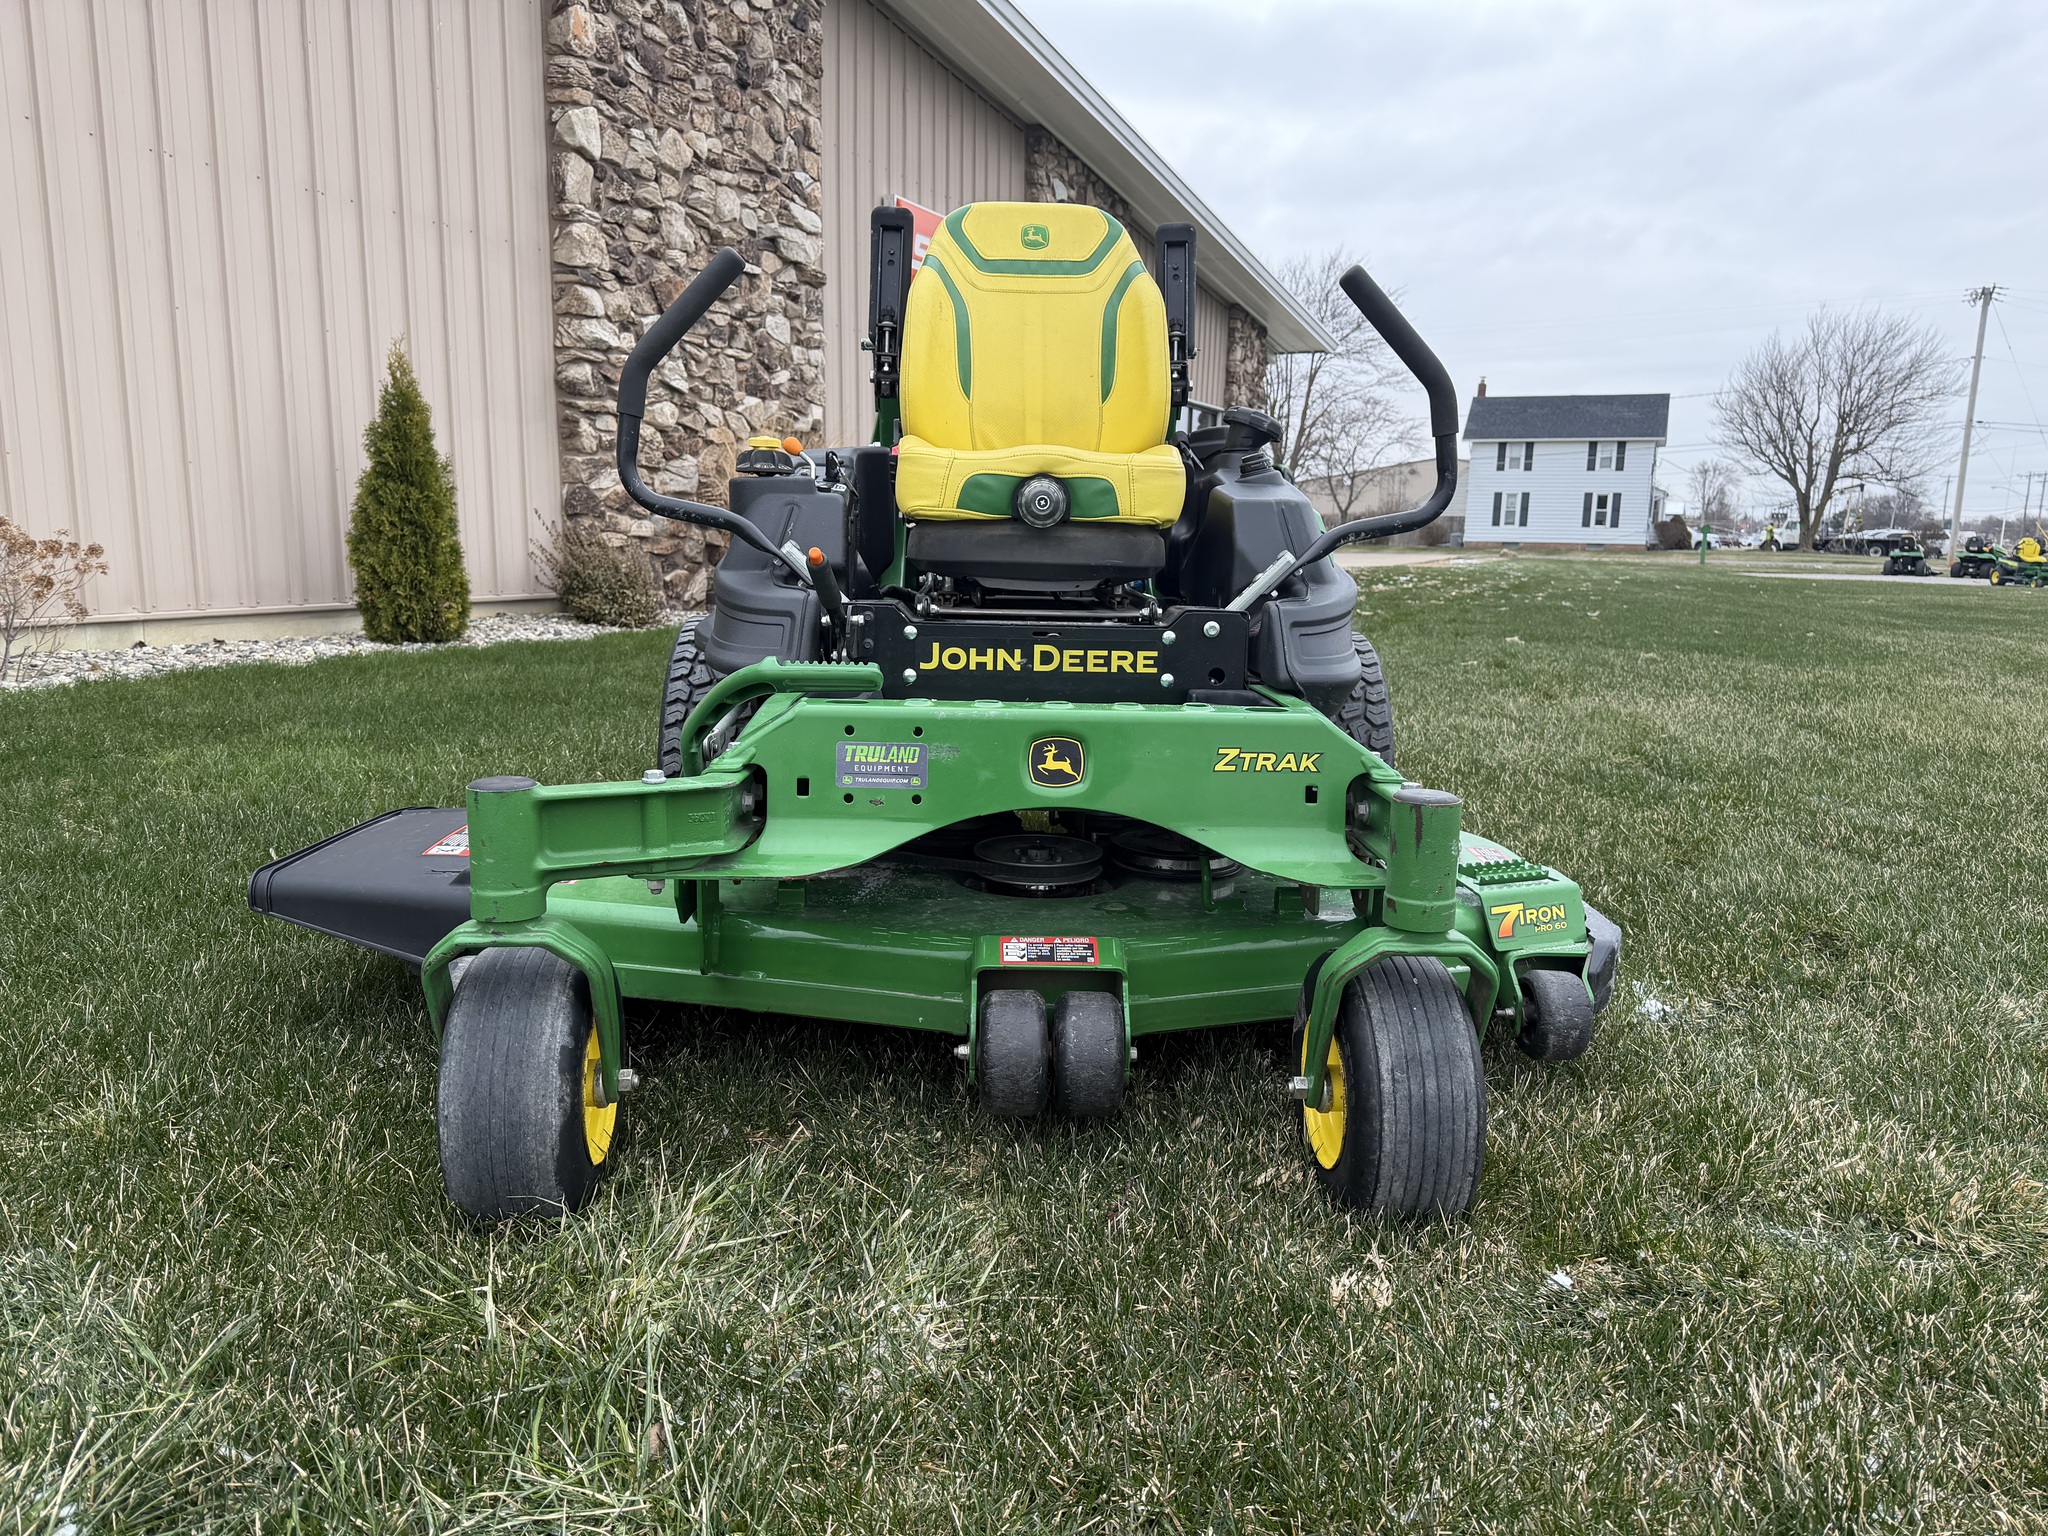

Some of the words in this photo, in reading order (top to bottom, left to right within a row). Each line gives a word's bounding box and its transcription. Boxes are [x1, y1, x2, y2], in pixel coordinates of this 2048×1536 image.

[919, 642, 1021, 671] JOHN
[1033, 644, 1159, 673] DEERE
[845, 745, 920, 764] TRULAND
[1213, 748, 1322, 773] ZTRAK
[854, 765, 910, 773] EQUIPMENT
[1534, 924, 1553, 933] PRO
[1555, 921, 1567, 930] 60
